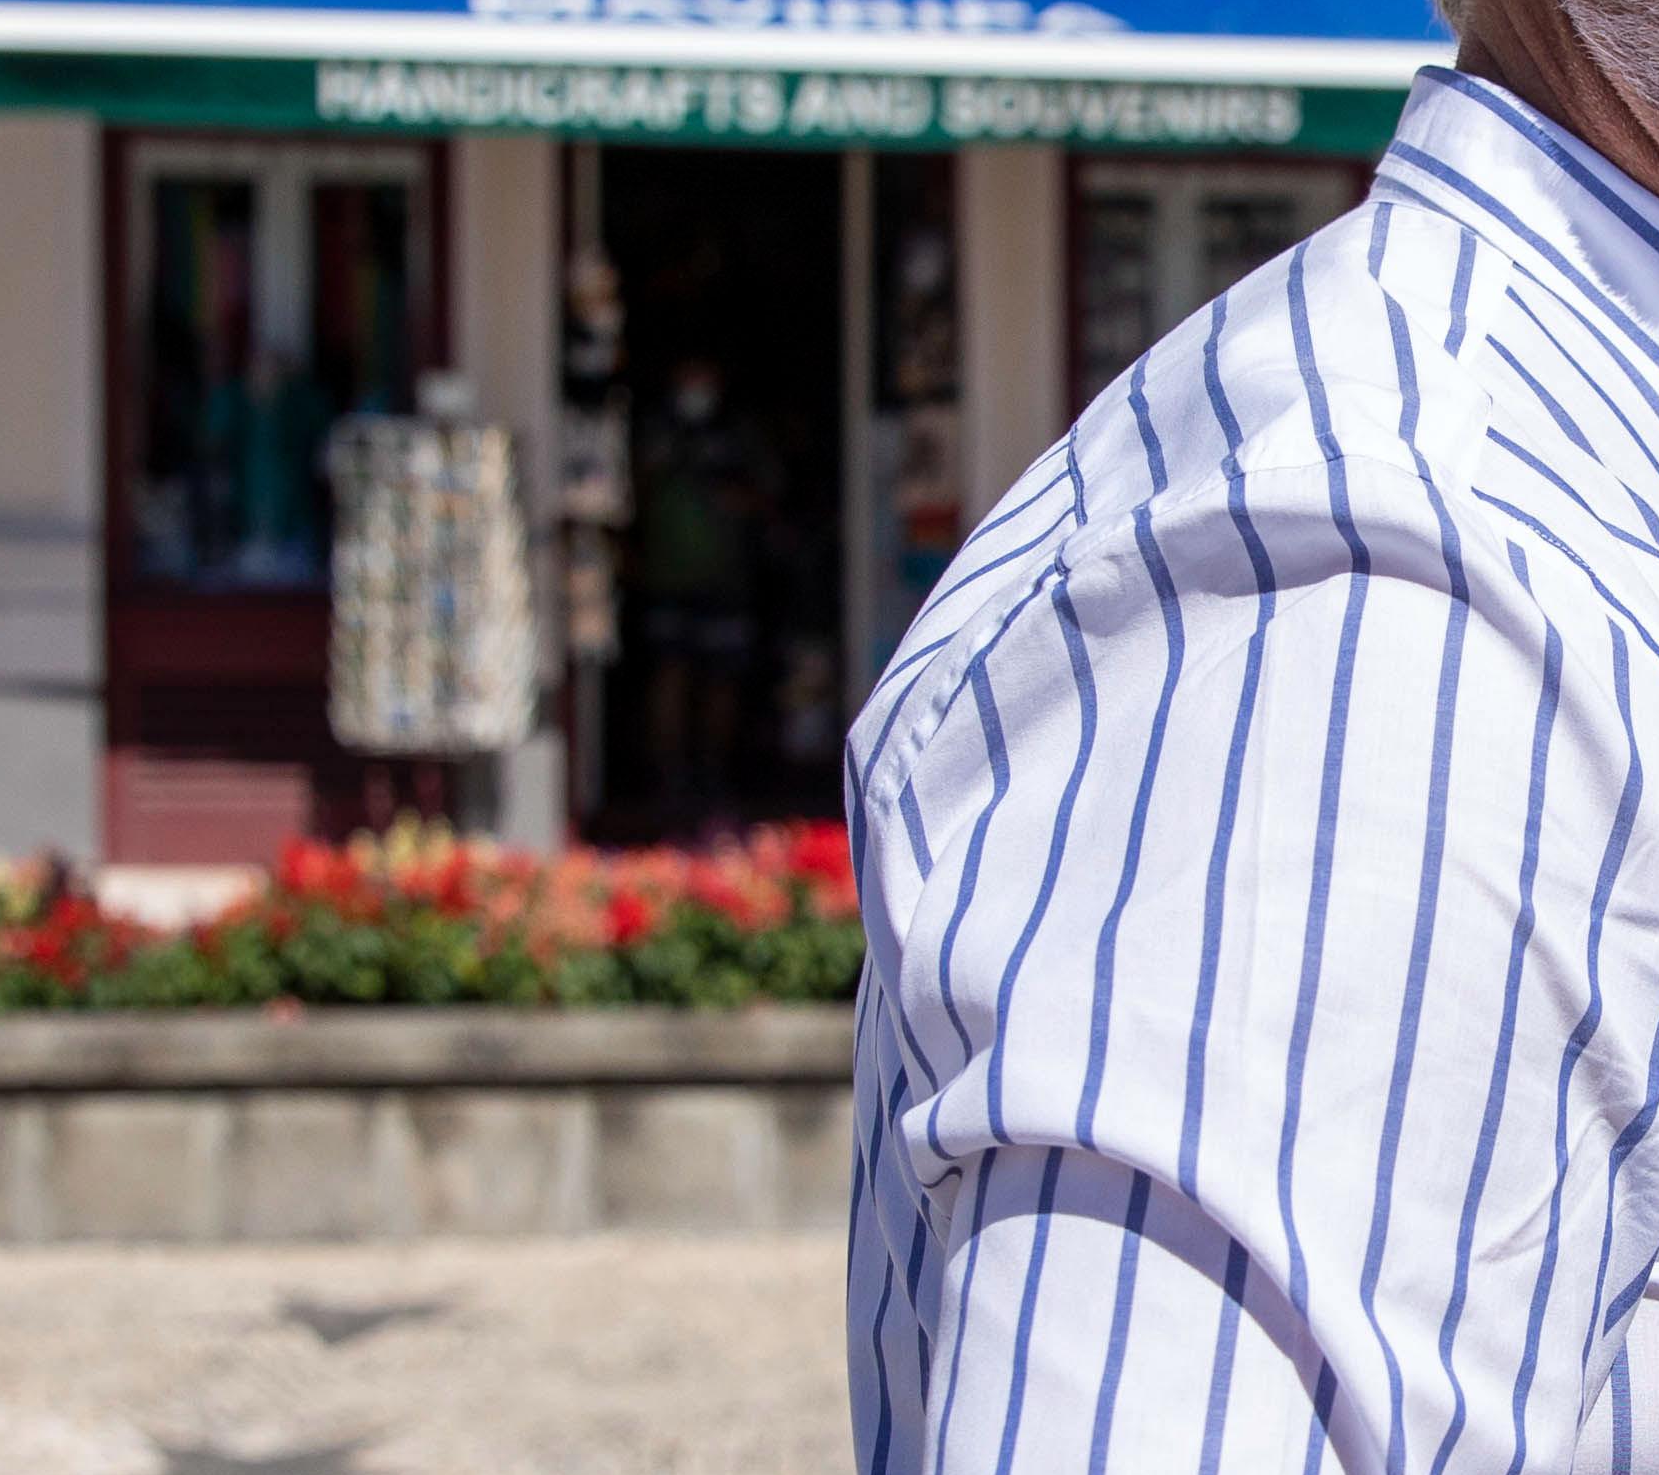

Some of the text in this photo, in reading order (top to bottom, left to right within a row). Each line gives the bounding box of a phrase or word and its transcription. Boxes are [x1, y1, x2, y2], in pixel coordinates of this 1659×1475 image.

[315, 64, 1299, 143] HANDICRAFTS AND SOUVENIRS
